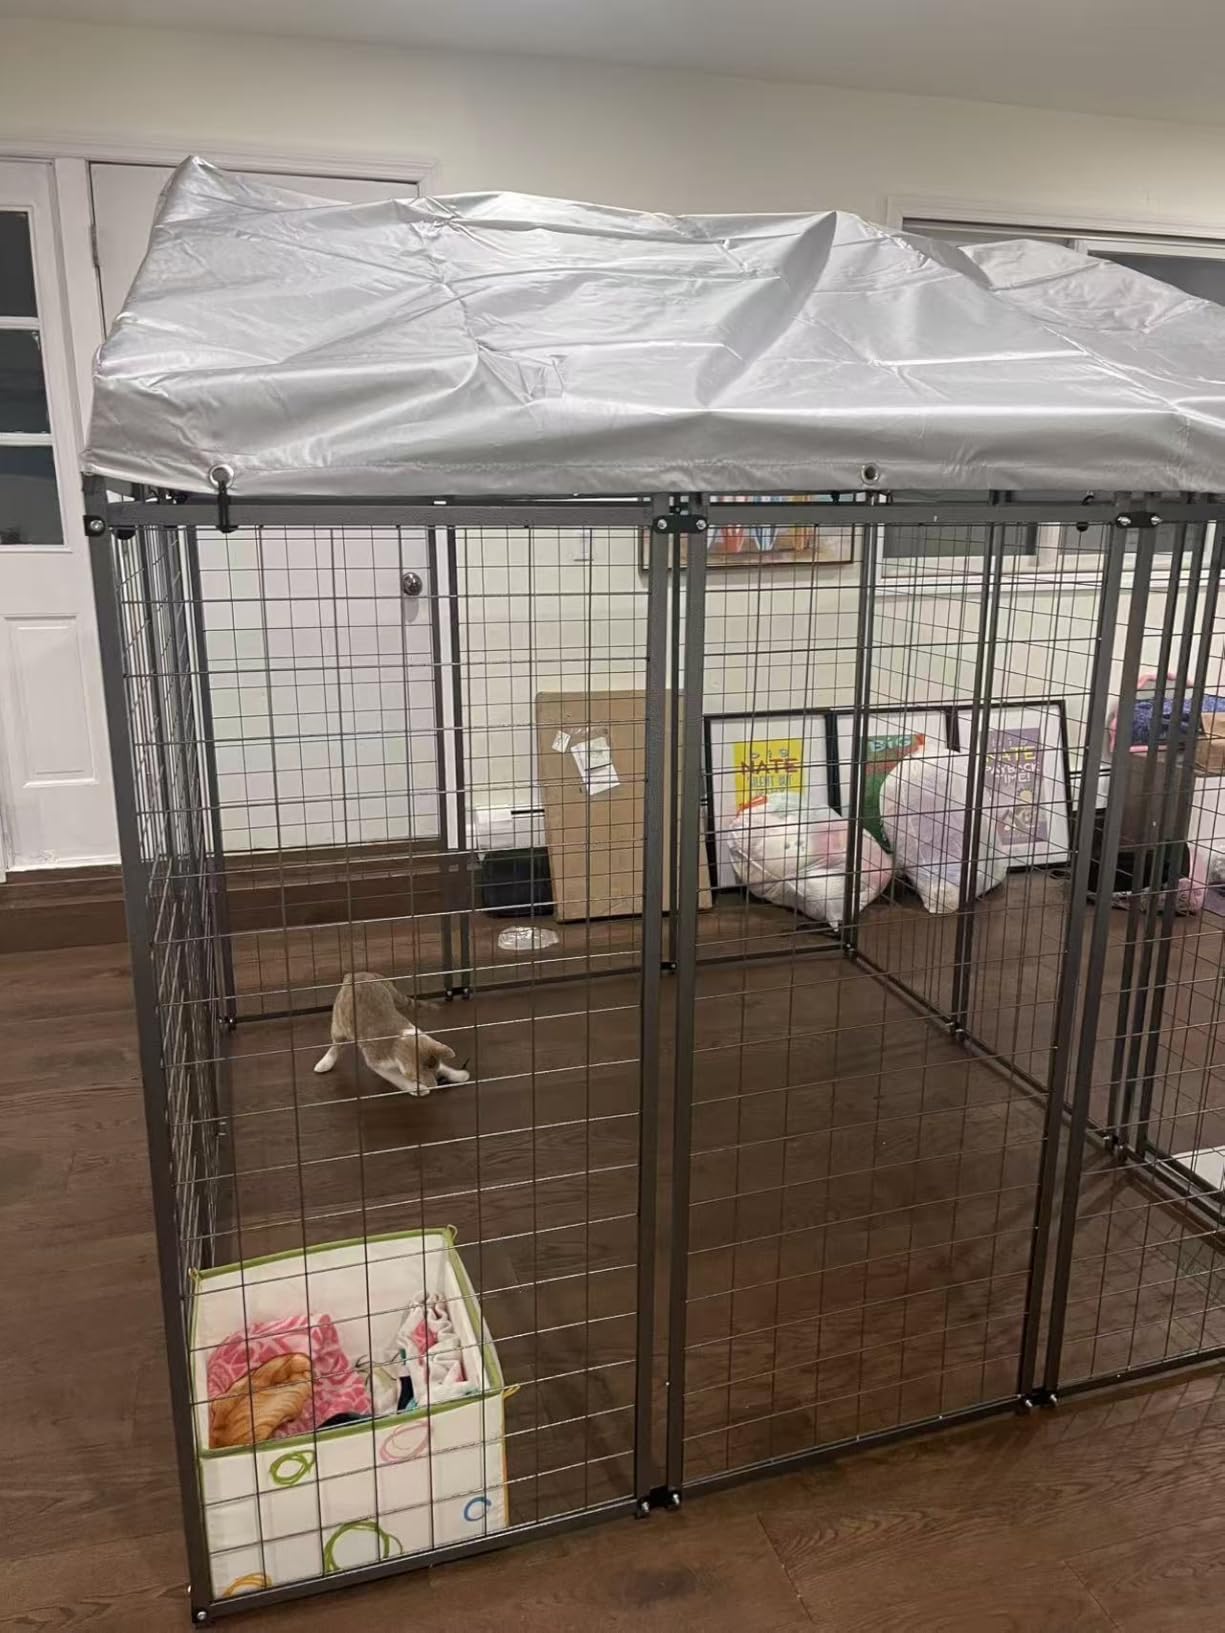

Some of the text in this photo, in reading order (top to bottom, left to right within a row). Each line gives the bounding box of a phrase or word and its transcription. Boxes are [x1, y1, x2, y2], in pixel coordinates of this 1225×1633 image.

[985, 746, 1036, 762] NATE
[741, 758, 798, 775] NATE
[985, 762, 1041, 775] PAYBACK
